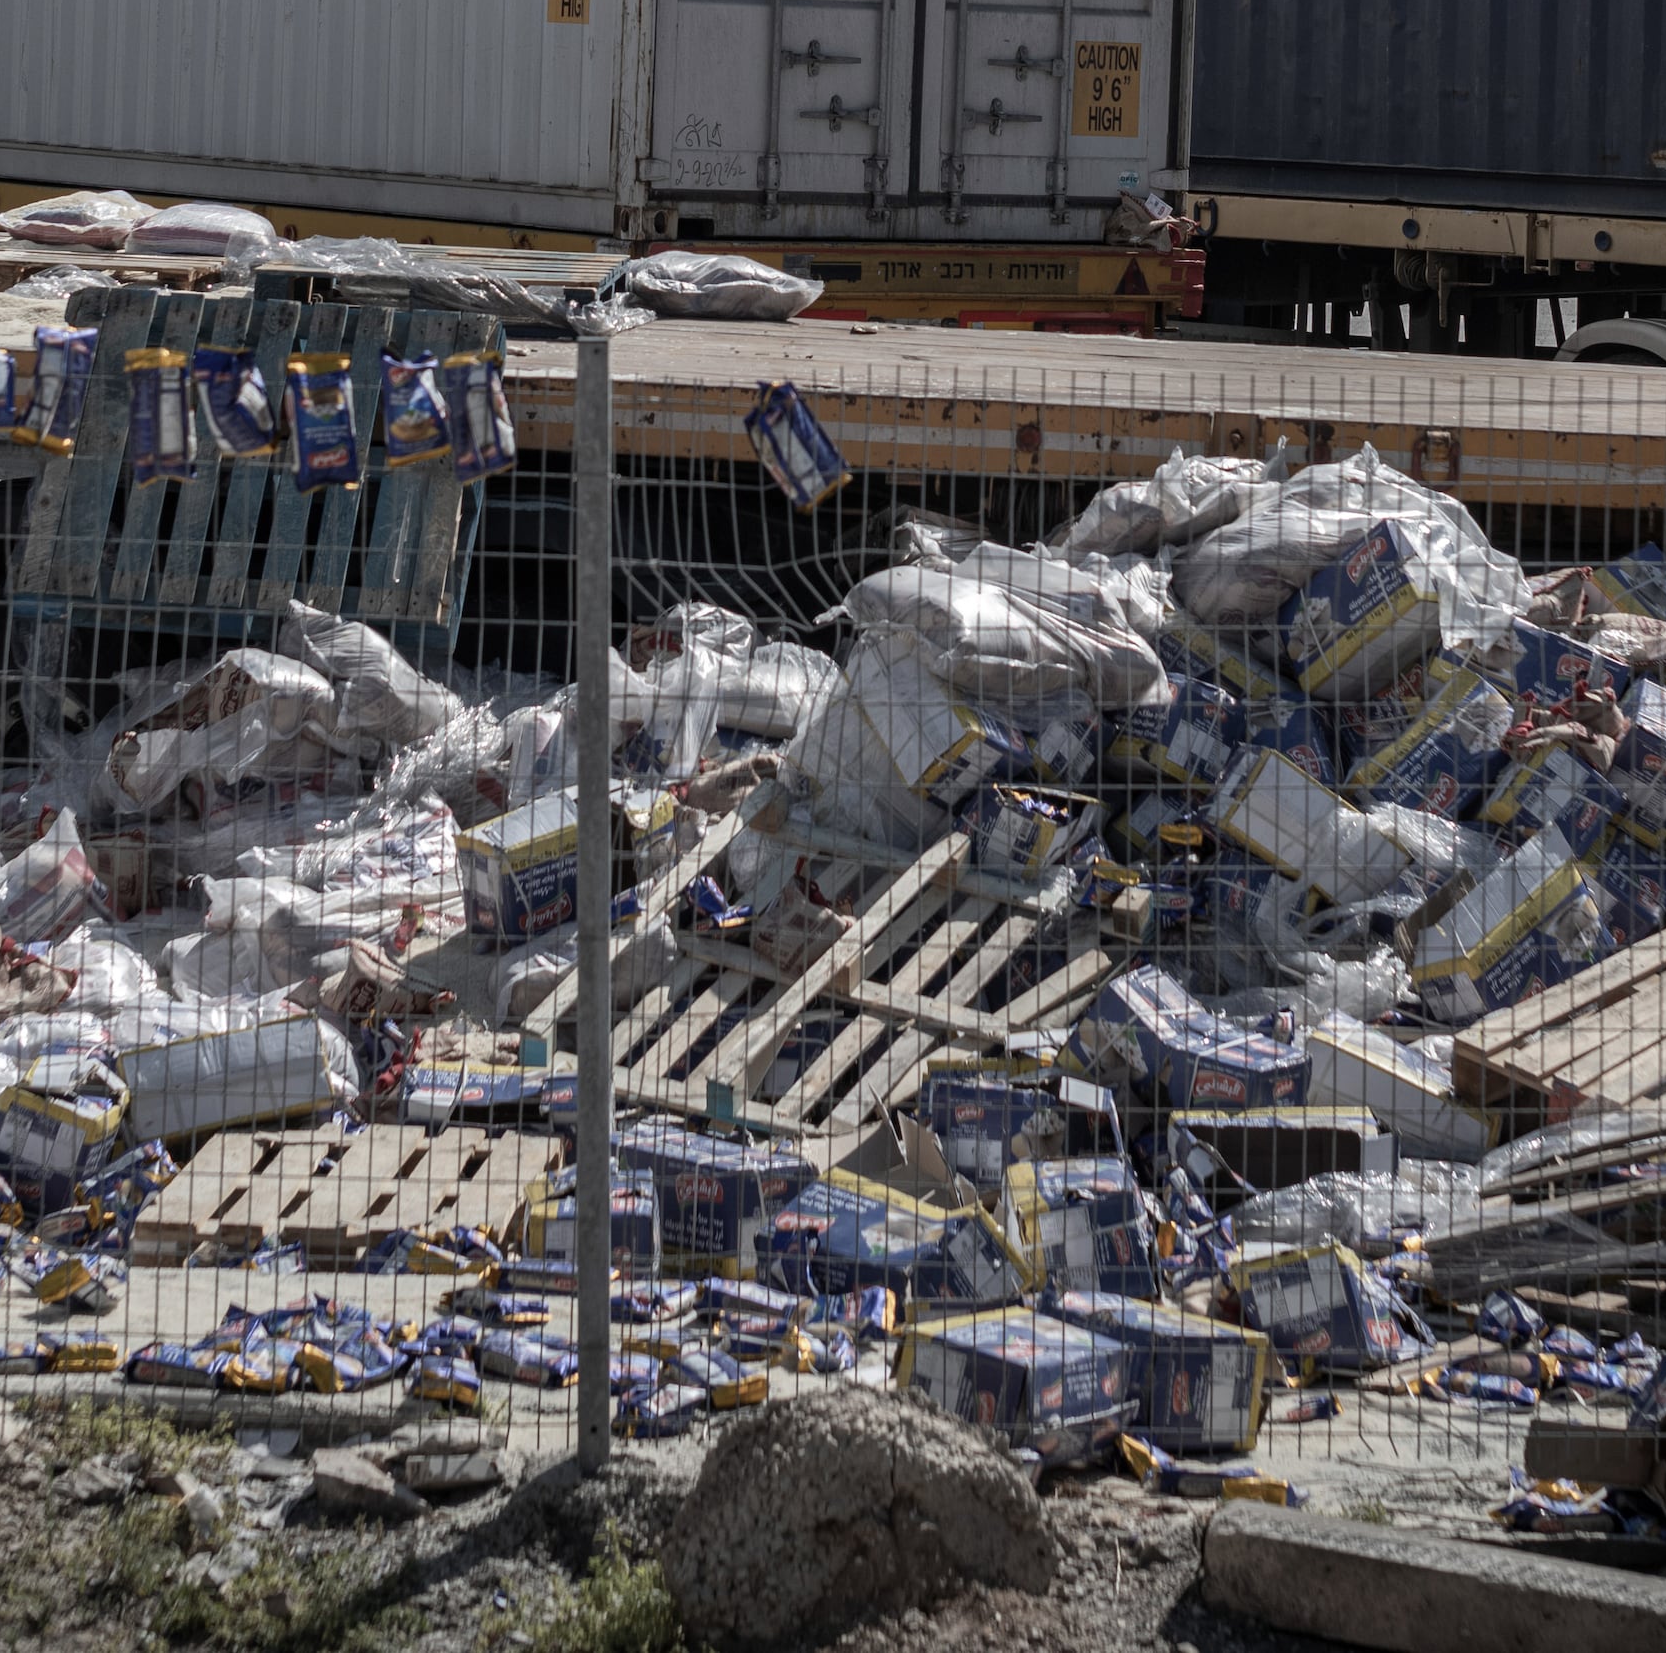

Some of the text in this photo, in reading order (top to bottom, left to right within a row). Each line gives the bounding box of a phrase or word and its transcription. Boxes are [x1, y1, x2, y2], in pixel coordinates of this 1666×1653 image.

[1077, 45, 1139, 71] CAUTION
[1089, 107, 1122, 132] HIGH
[878, 262, 922, 283] ארוך
[940, 262, 975, 279] רכב
[1007, 263, 1066, 280] זהירות
